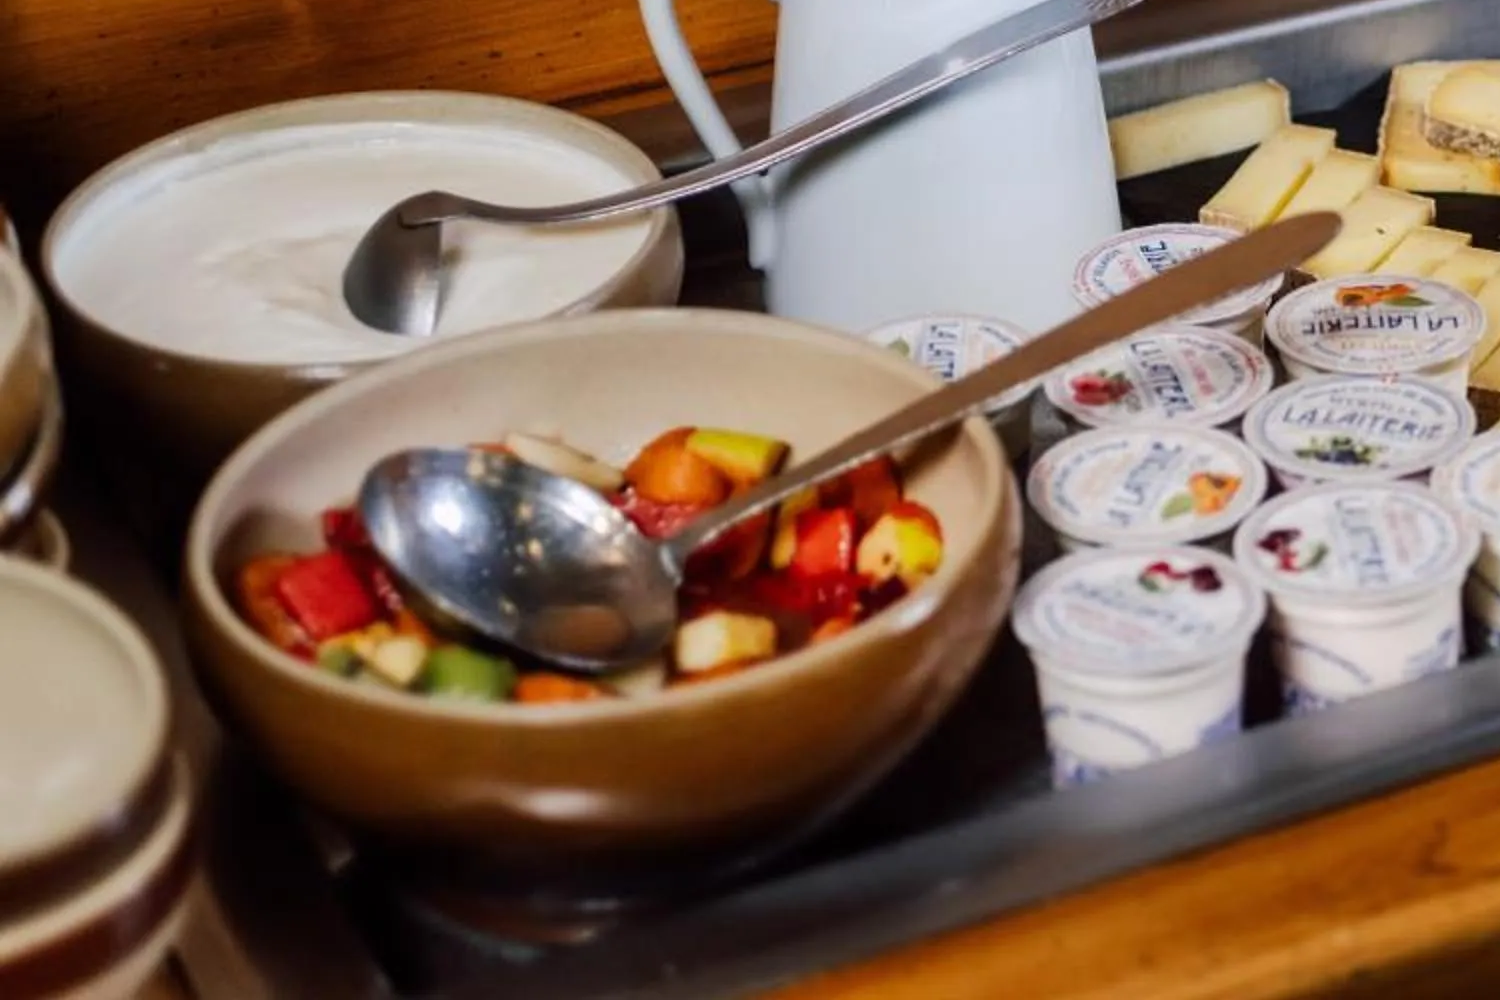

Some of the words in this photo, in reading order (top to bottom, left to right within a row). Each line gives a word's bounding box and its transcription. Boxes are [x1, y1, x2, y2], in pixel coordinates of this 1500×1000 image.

[1302, 313, 1419, 336] LAITERIE
[1427, 314, 1459, 332] LA
[1282, 403, 1319, 425] LA
[1322, 408, 1444, 440] LAITERIE
